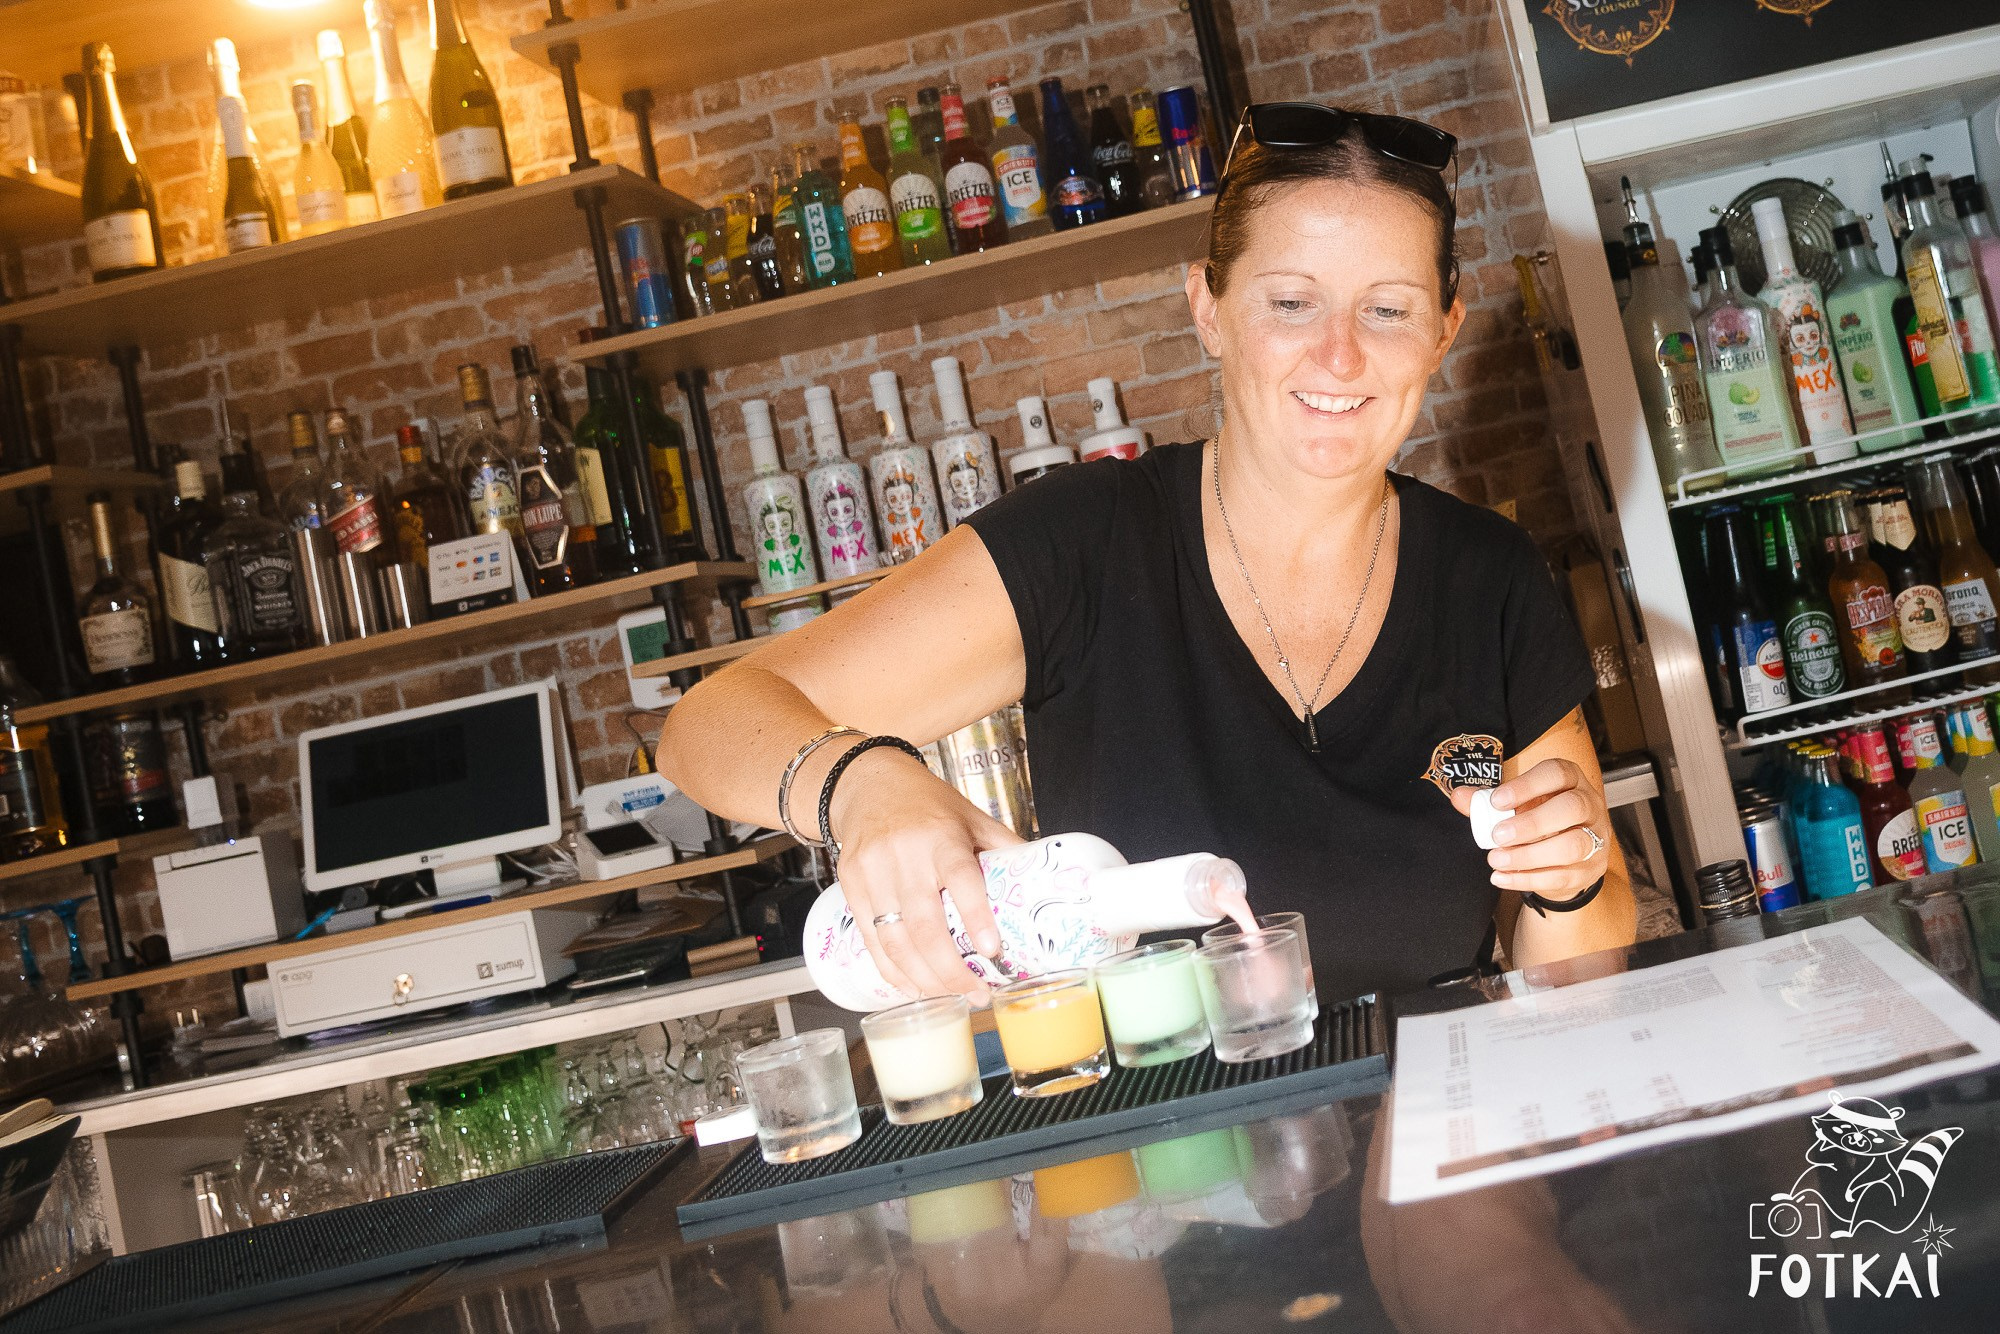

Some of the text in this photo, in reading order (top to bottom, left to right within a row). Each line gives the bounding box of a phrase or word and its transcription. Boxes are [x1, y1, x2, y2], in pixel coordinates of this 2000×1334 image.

[1007, 171, 1032, 188] ICE
[808, 206, 827, 247] WKD
[1795, 361, 1836, 394] MEX
[538, 502, 563, 526] LUPE
[891, 519, 927, 547] MEX
[831, 533, 868, 564] MEX
[769, 547, 806, 578] MEX
[1945, 586, 1979, 601] orona
[1464, 777, 1493, 786] LOUNGE
[1938, 820, 1966, 840] ICE
[1849, 829, 1867, 877] WKD
[1757, 863, 1783, 883] Bull
